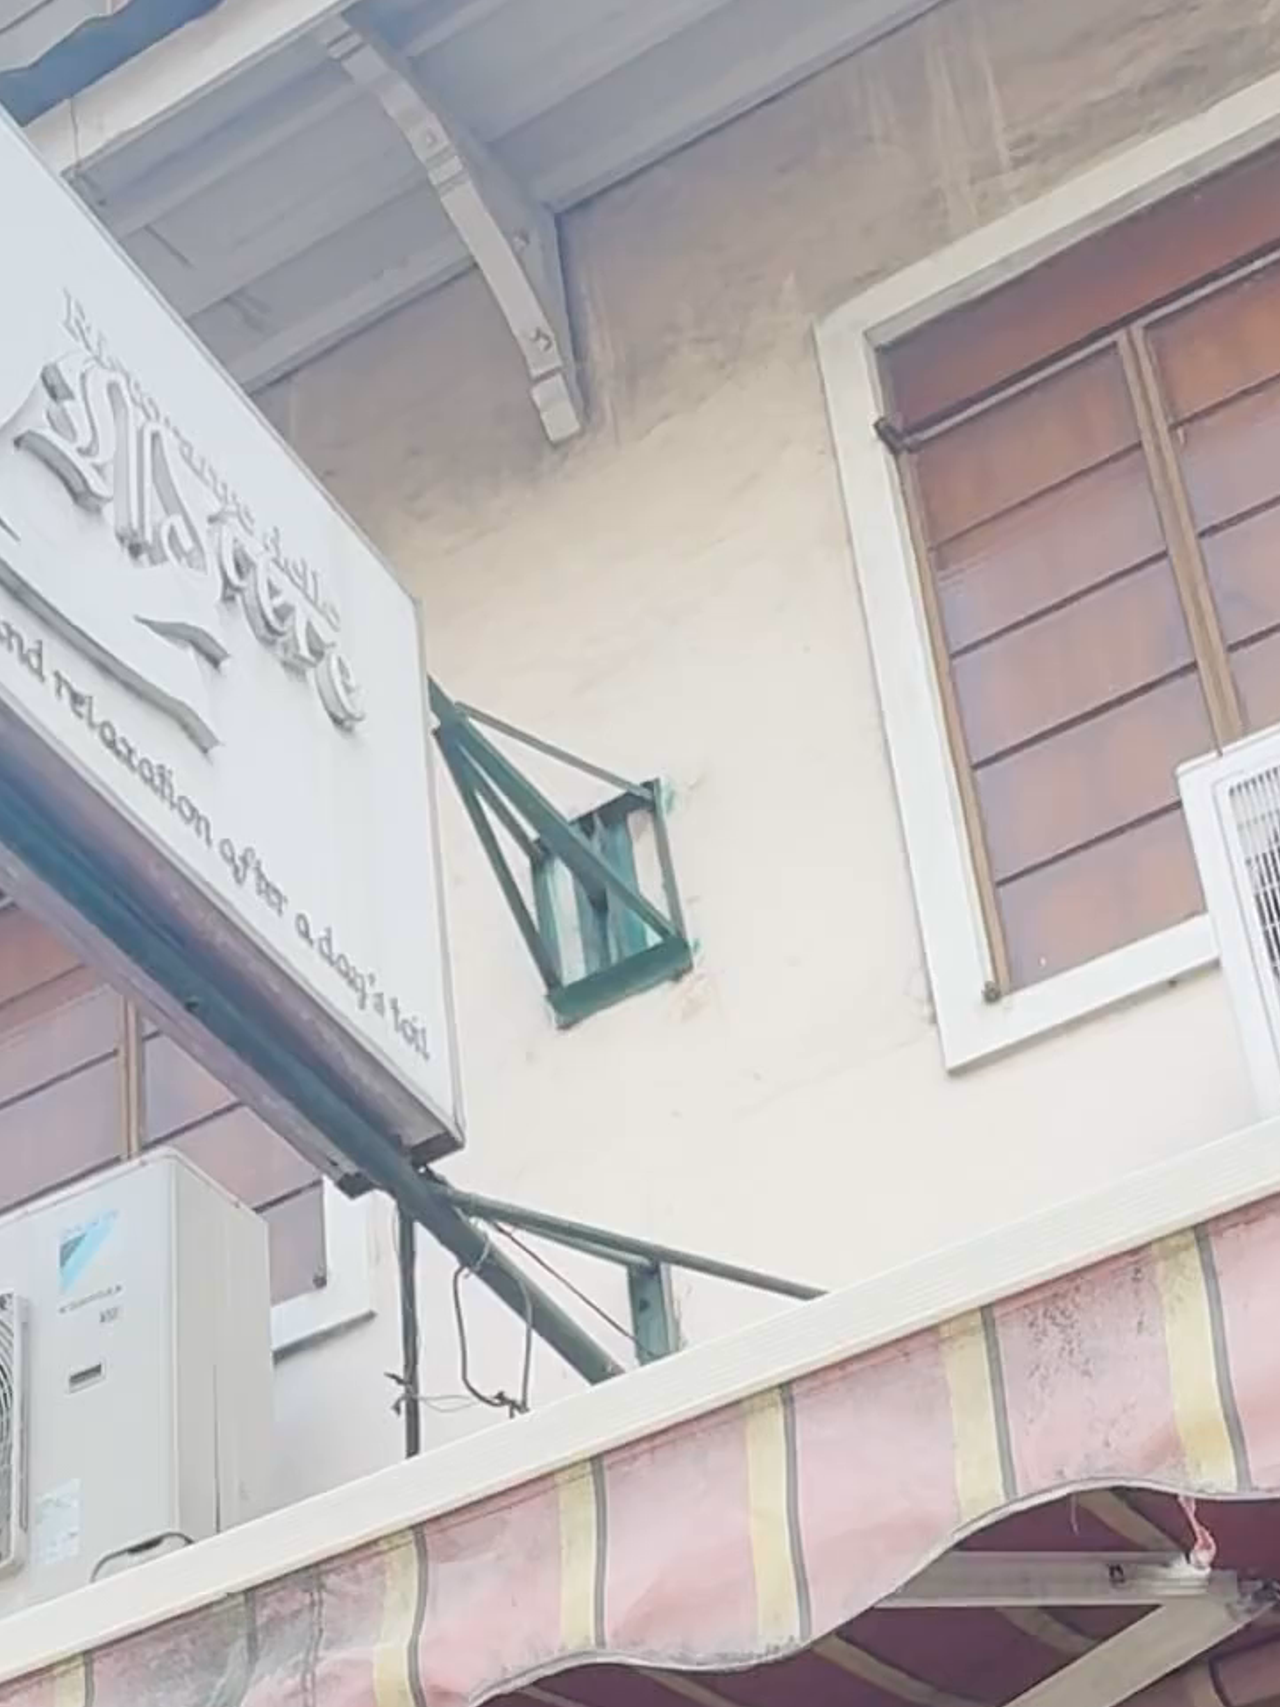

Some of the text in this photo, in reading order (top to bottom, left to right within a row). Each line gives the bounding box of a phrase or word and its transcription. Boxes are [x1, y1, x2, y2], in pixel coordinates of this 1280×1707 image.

[53, 667, 212, 847] relaxation
[220, 836, 289, 917] after
[294, 913, 316, 948] a
[391, 991, 432, 1061] toil
